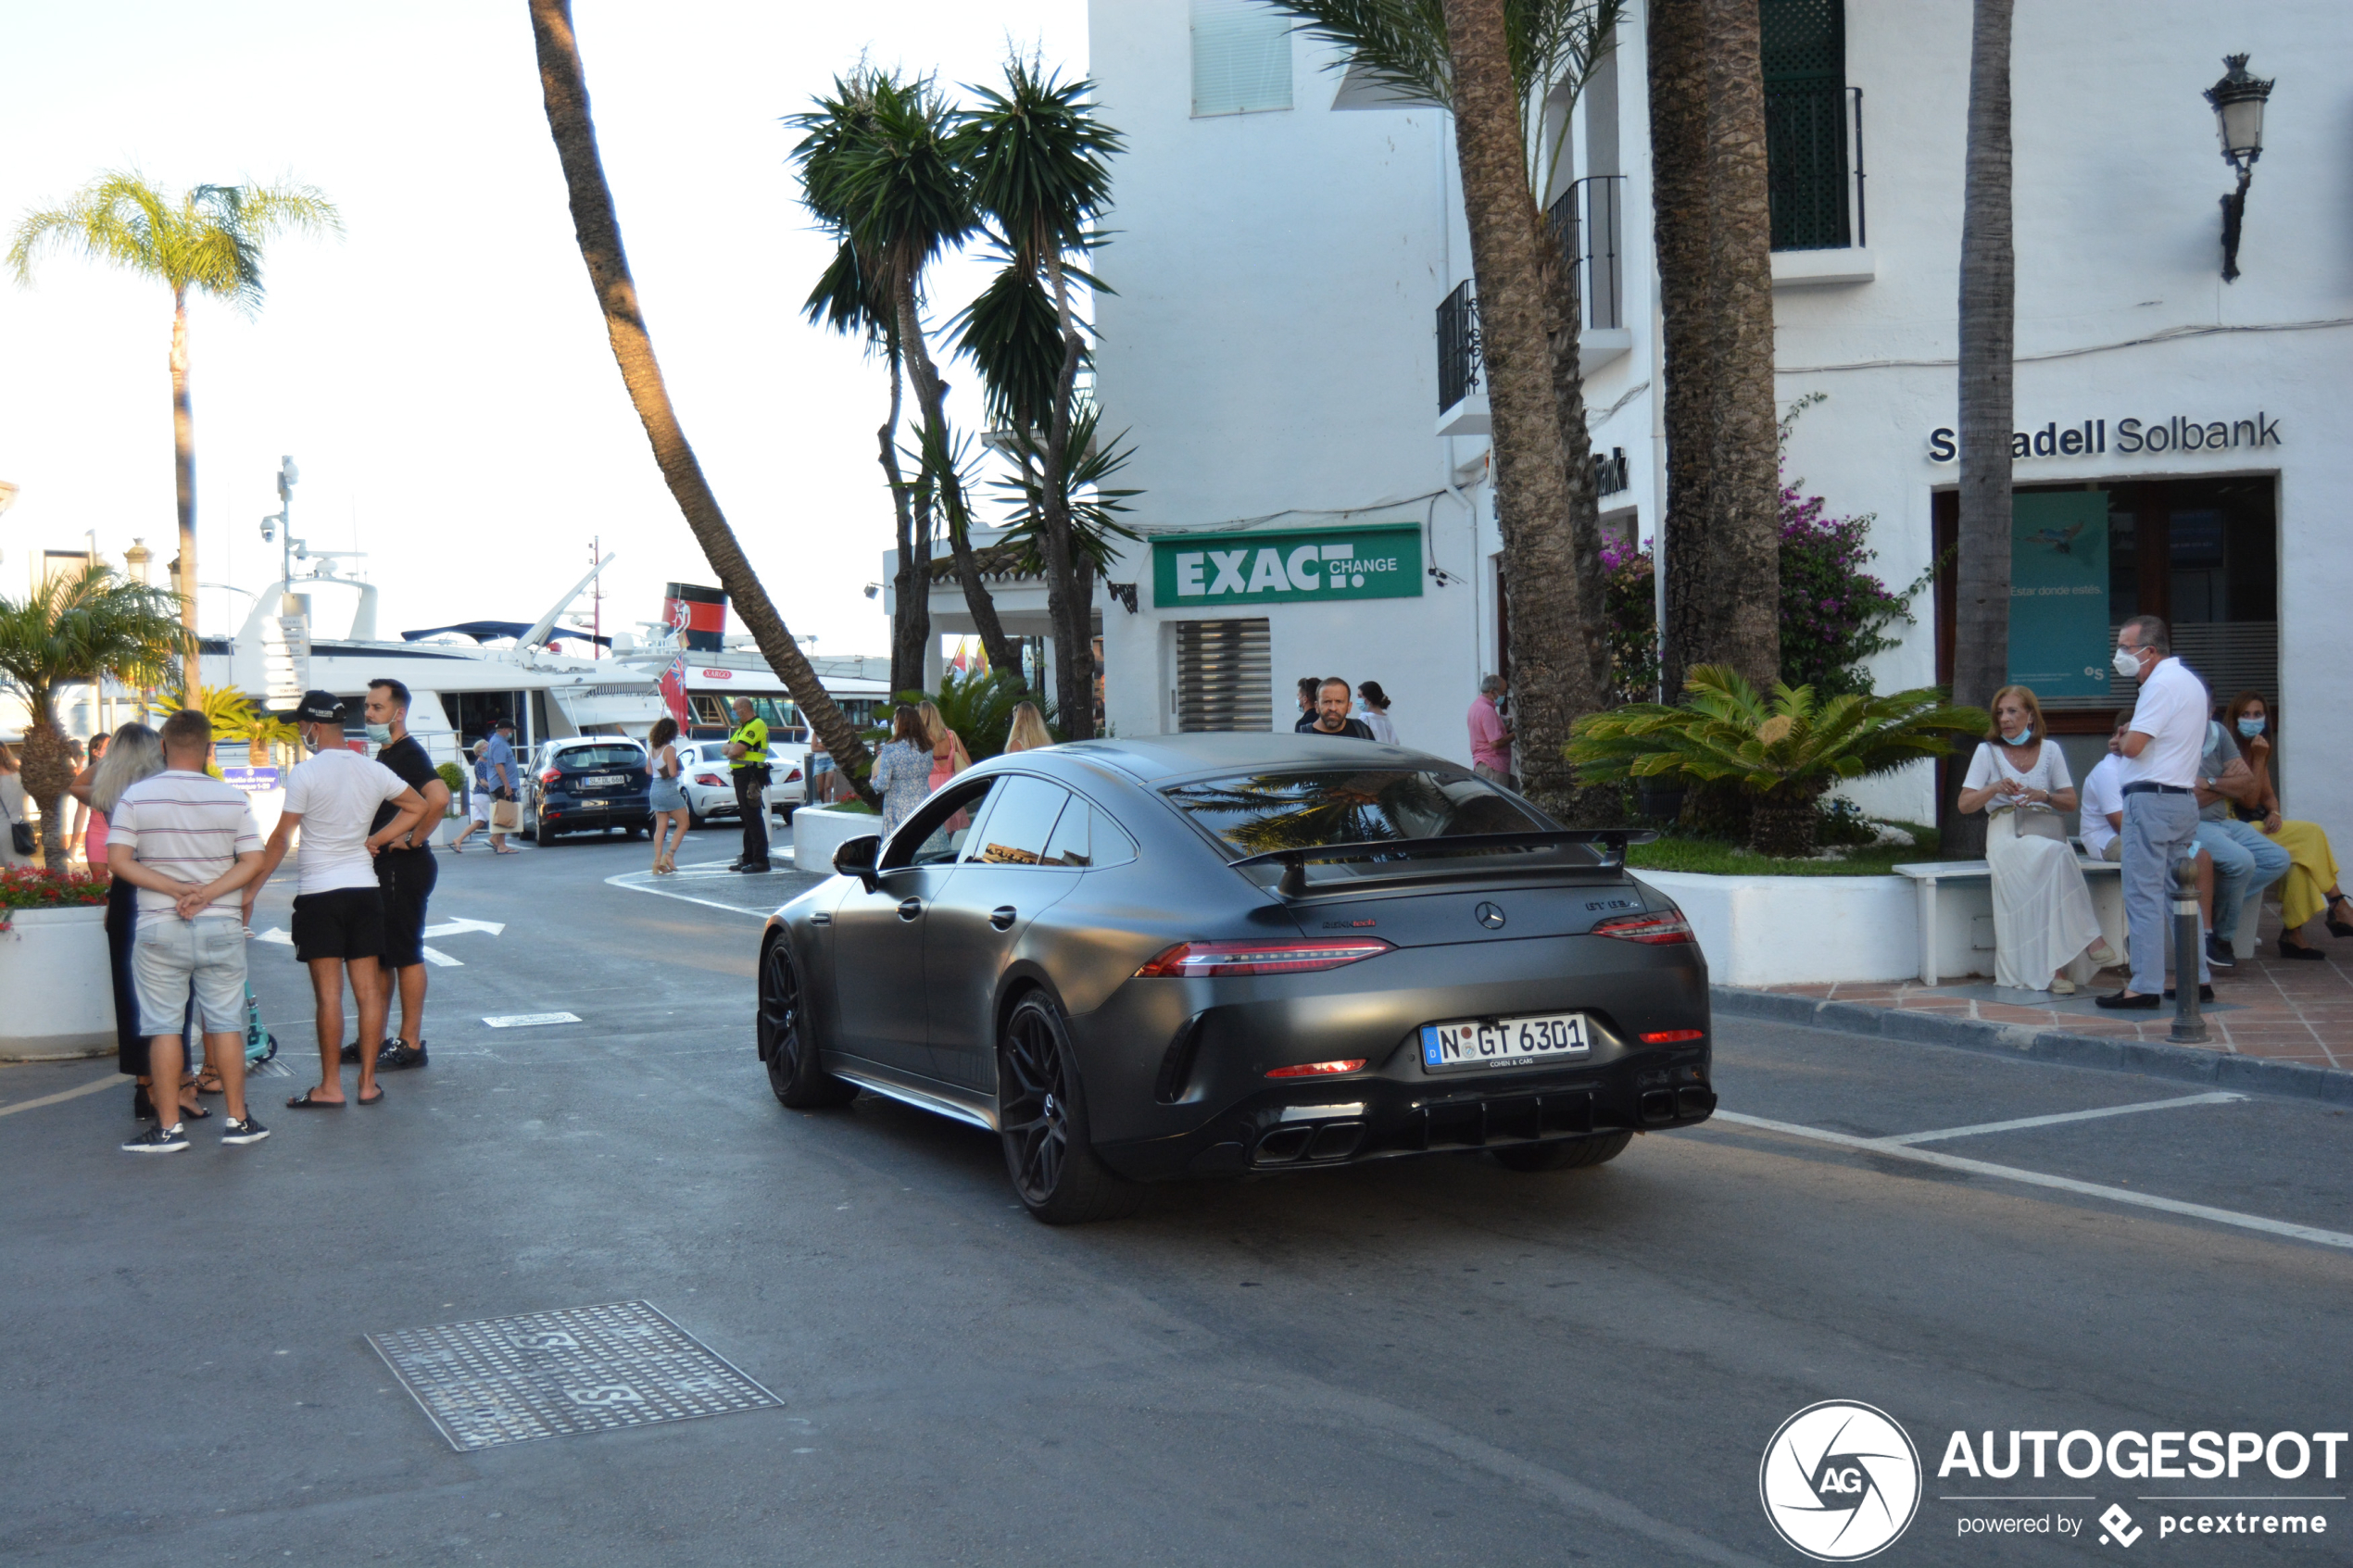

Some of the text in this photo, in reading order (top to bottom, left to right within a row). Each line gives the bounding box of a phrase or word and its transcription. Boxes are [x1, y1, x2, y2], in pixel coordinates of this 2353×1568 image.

[1930, 411, 2282, 462] Sadell Solbank
[1329, 558, 1398, 574] CHANGE
[2010, 585, 2035, 596] Estar
[2038, 585, 2070, 596] donde
[705, 670, 730, 678] XARGO
[1441, 1020, 1585, 1059] N GT 6301
[1429, 1049, 1437, 1059] D
[1490, 1060, 1511, 1068] COHEN
